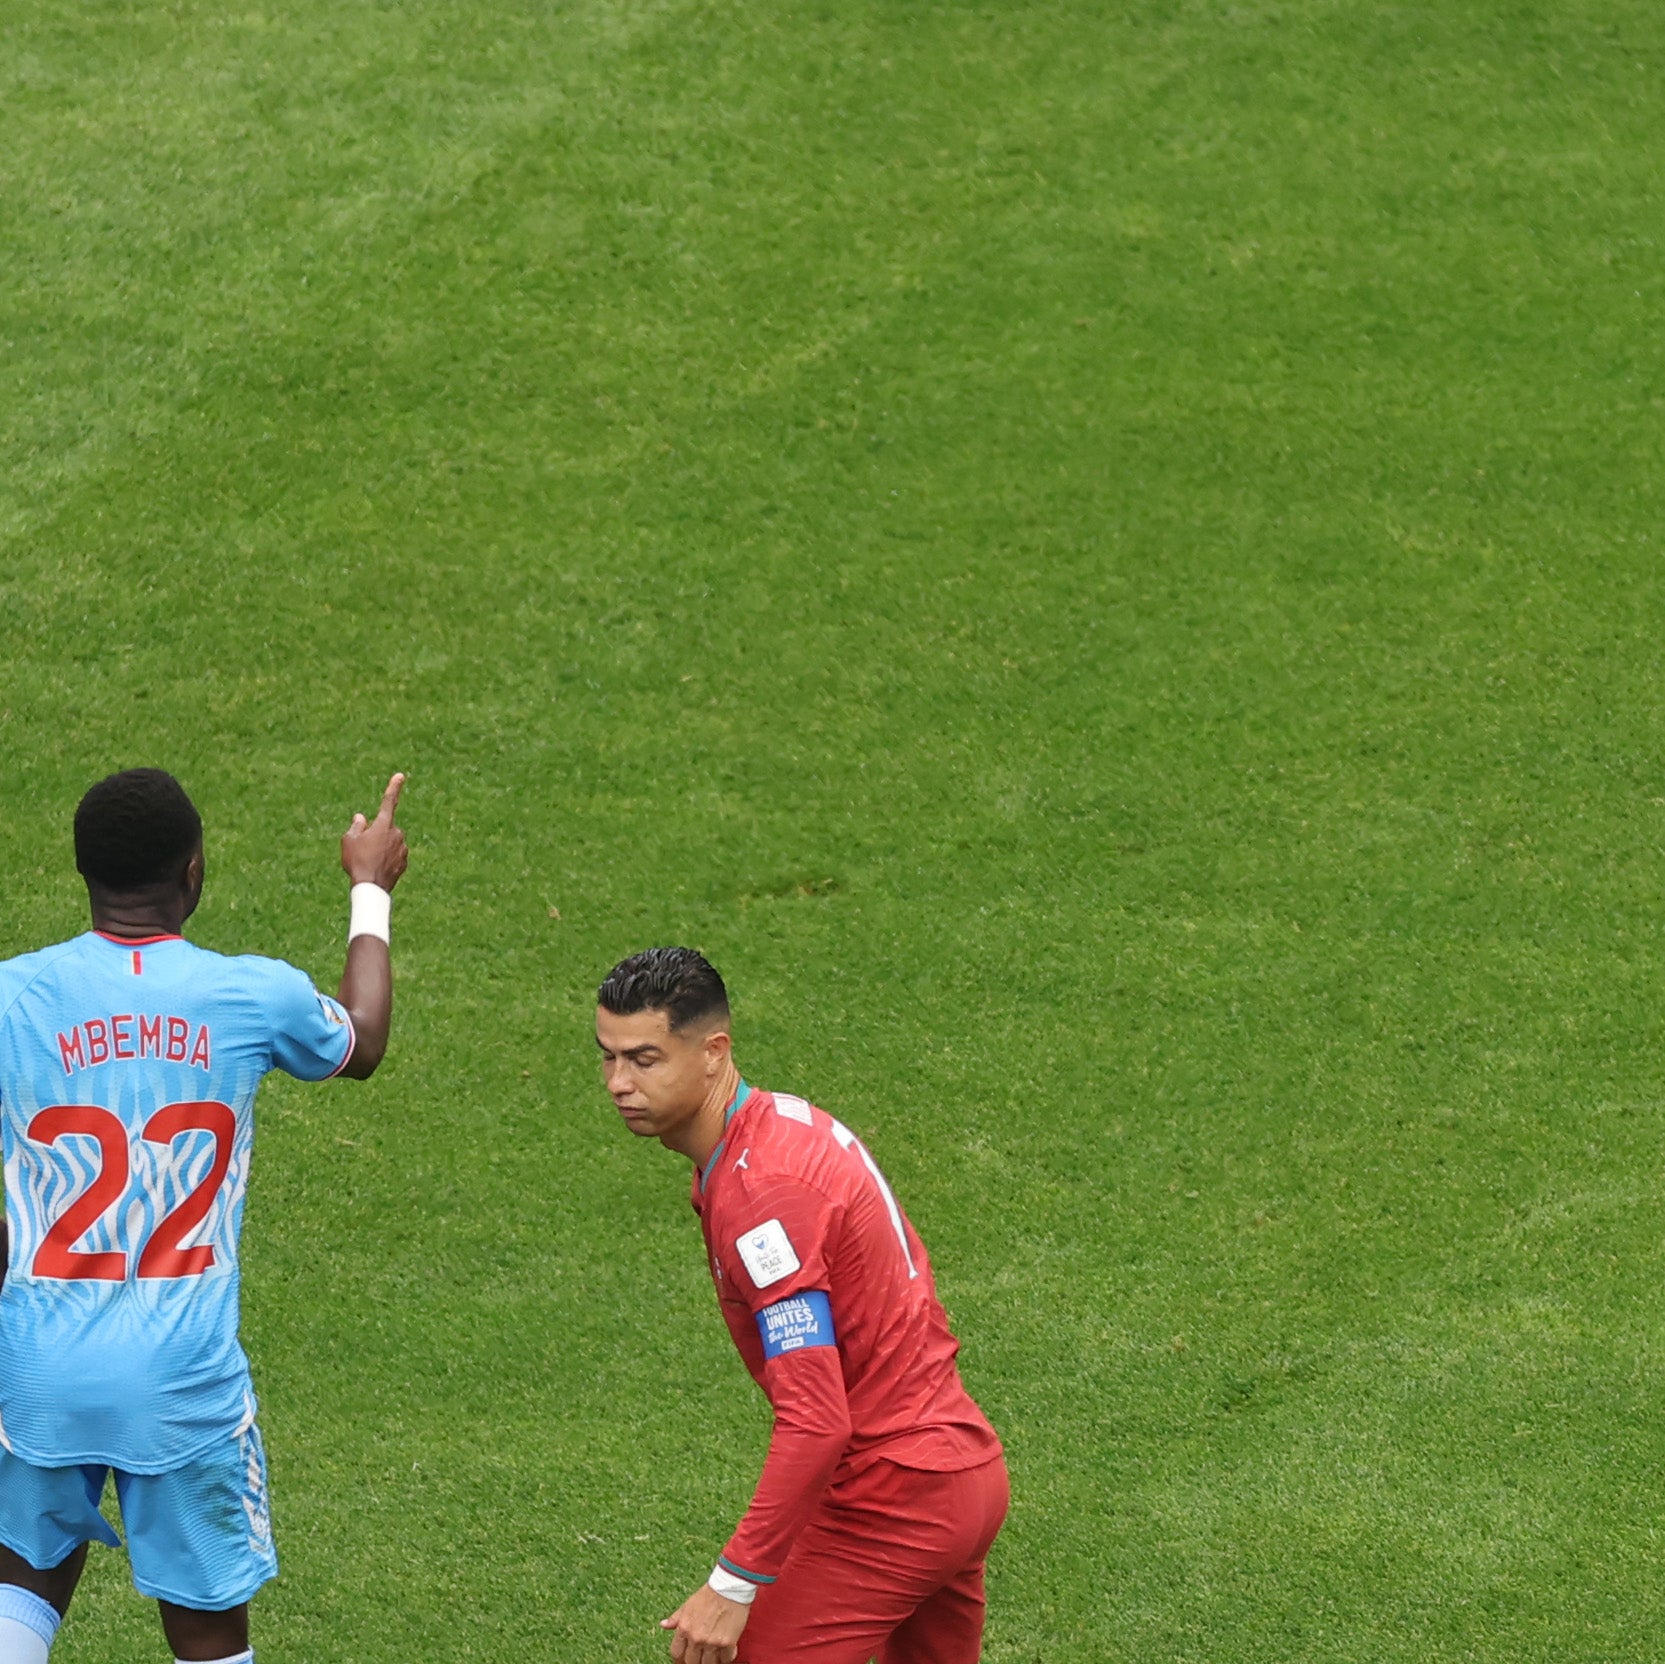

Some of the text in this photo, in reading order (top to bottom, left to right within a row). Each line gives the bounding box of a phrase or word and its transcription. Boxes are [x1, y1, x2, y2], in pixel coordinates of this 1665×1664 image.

[57, 1013, 211, 1076] MBEMBA
[27, 1100, 237, 1282] 22
[762, 1298, 809, 1318] FOOTBALL
[766, 1307, 814, 1331] UNITES
[768, 1320, 819, 1344] the World
